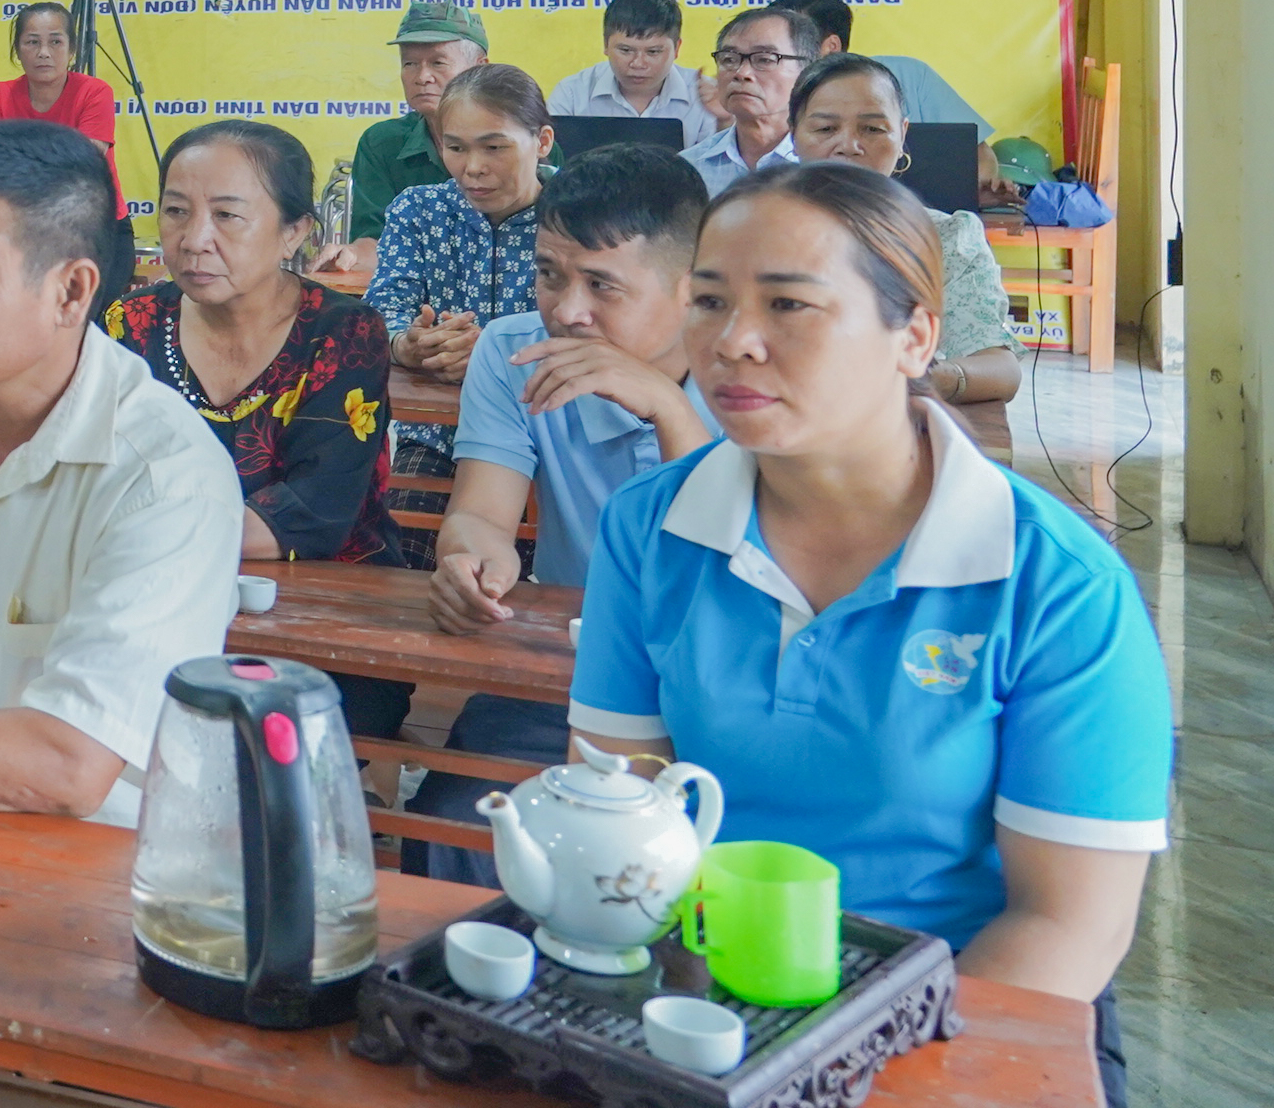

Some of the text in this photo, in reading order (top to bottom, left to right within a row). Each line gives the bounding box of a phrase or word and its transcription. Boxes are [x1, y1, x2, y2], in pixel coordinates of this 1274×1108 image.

[144, 0, 196, 14] (ĐƠN
[154, 101, 207, 117] (ĐƠN
[215, 101, 266, 119] TỈNH
[272, 102, 319, 118] DÂN
[326, 102, 391, 118] NHÂN
